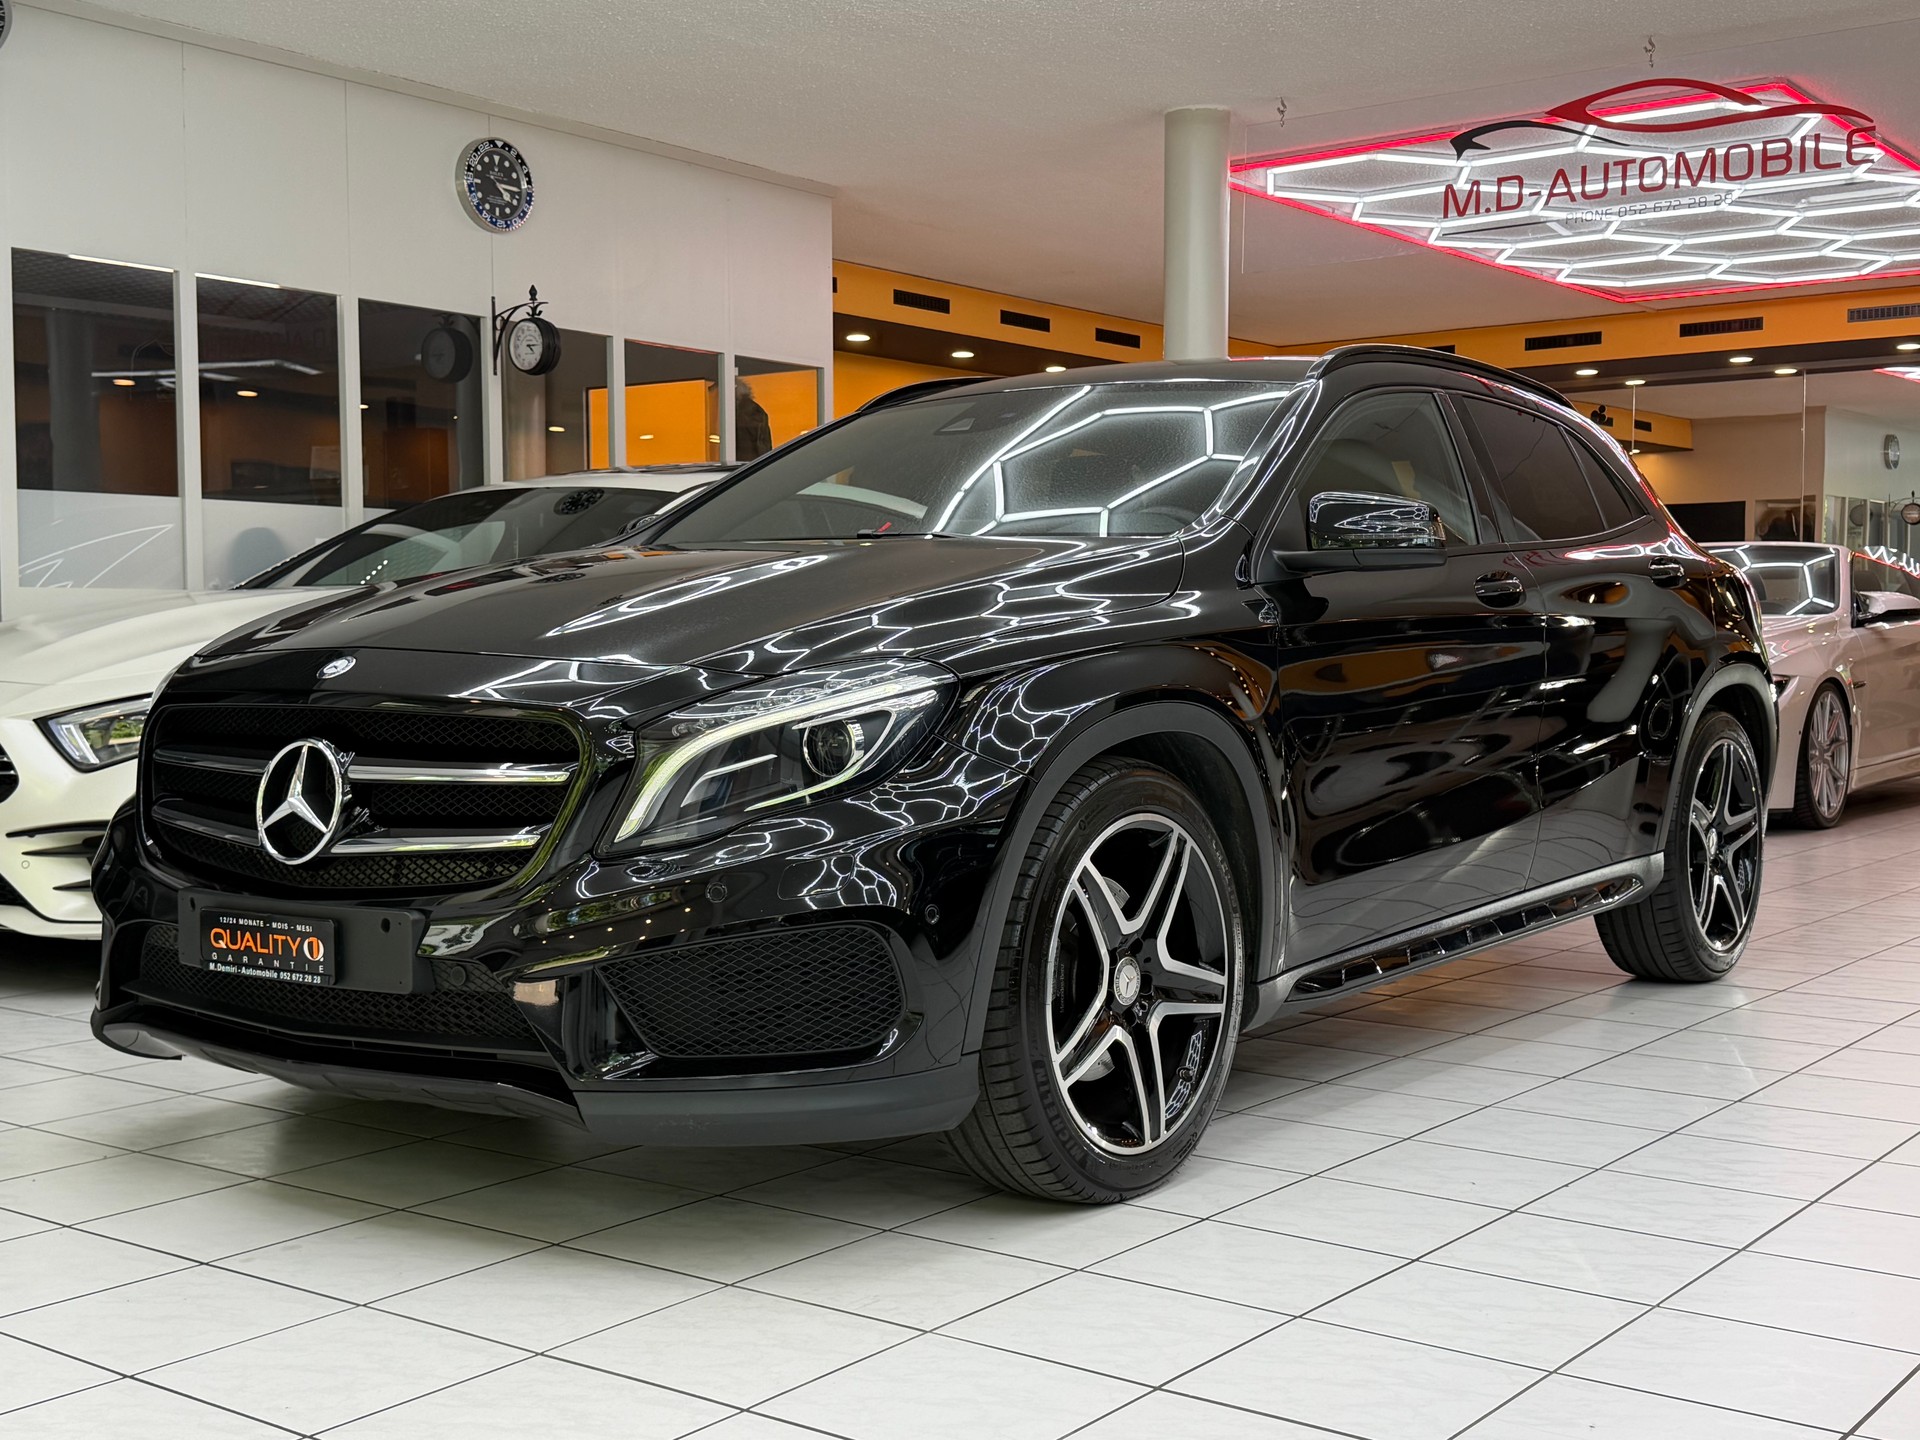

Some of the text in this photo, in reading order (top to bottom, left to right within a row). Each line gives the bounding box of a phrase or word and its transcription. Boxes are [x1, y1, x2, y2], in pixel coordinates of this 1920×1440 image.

[1442, 125, 1876, 219] M.D-AUTOMOBILE
[1565, 192, 1733, 224] PHONE 052 672 28 28
[219, 916, 237, 924] 12/24
[238, 918, 265, 927] MONATE
[271, 921, 289, 930] MOIS
[296, 924, 313, 932] MESI
[210, 927, 302, 957] QUALITY
[279, 971, 291, 980] 052
[292, 973, 303, 982] 672
[304, 974, 312, 983] 28
[313, 975, 321, 984] 28
[1034, 1066, 1089, 1163] MICHELIN
